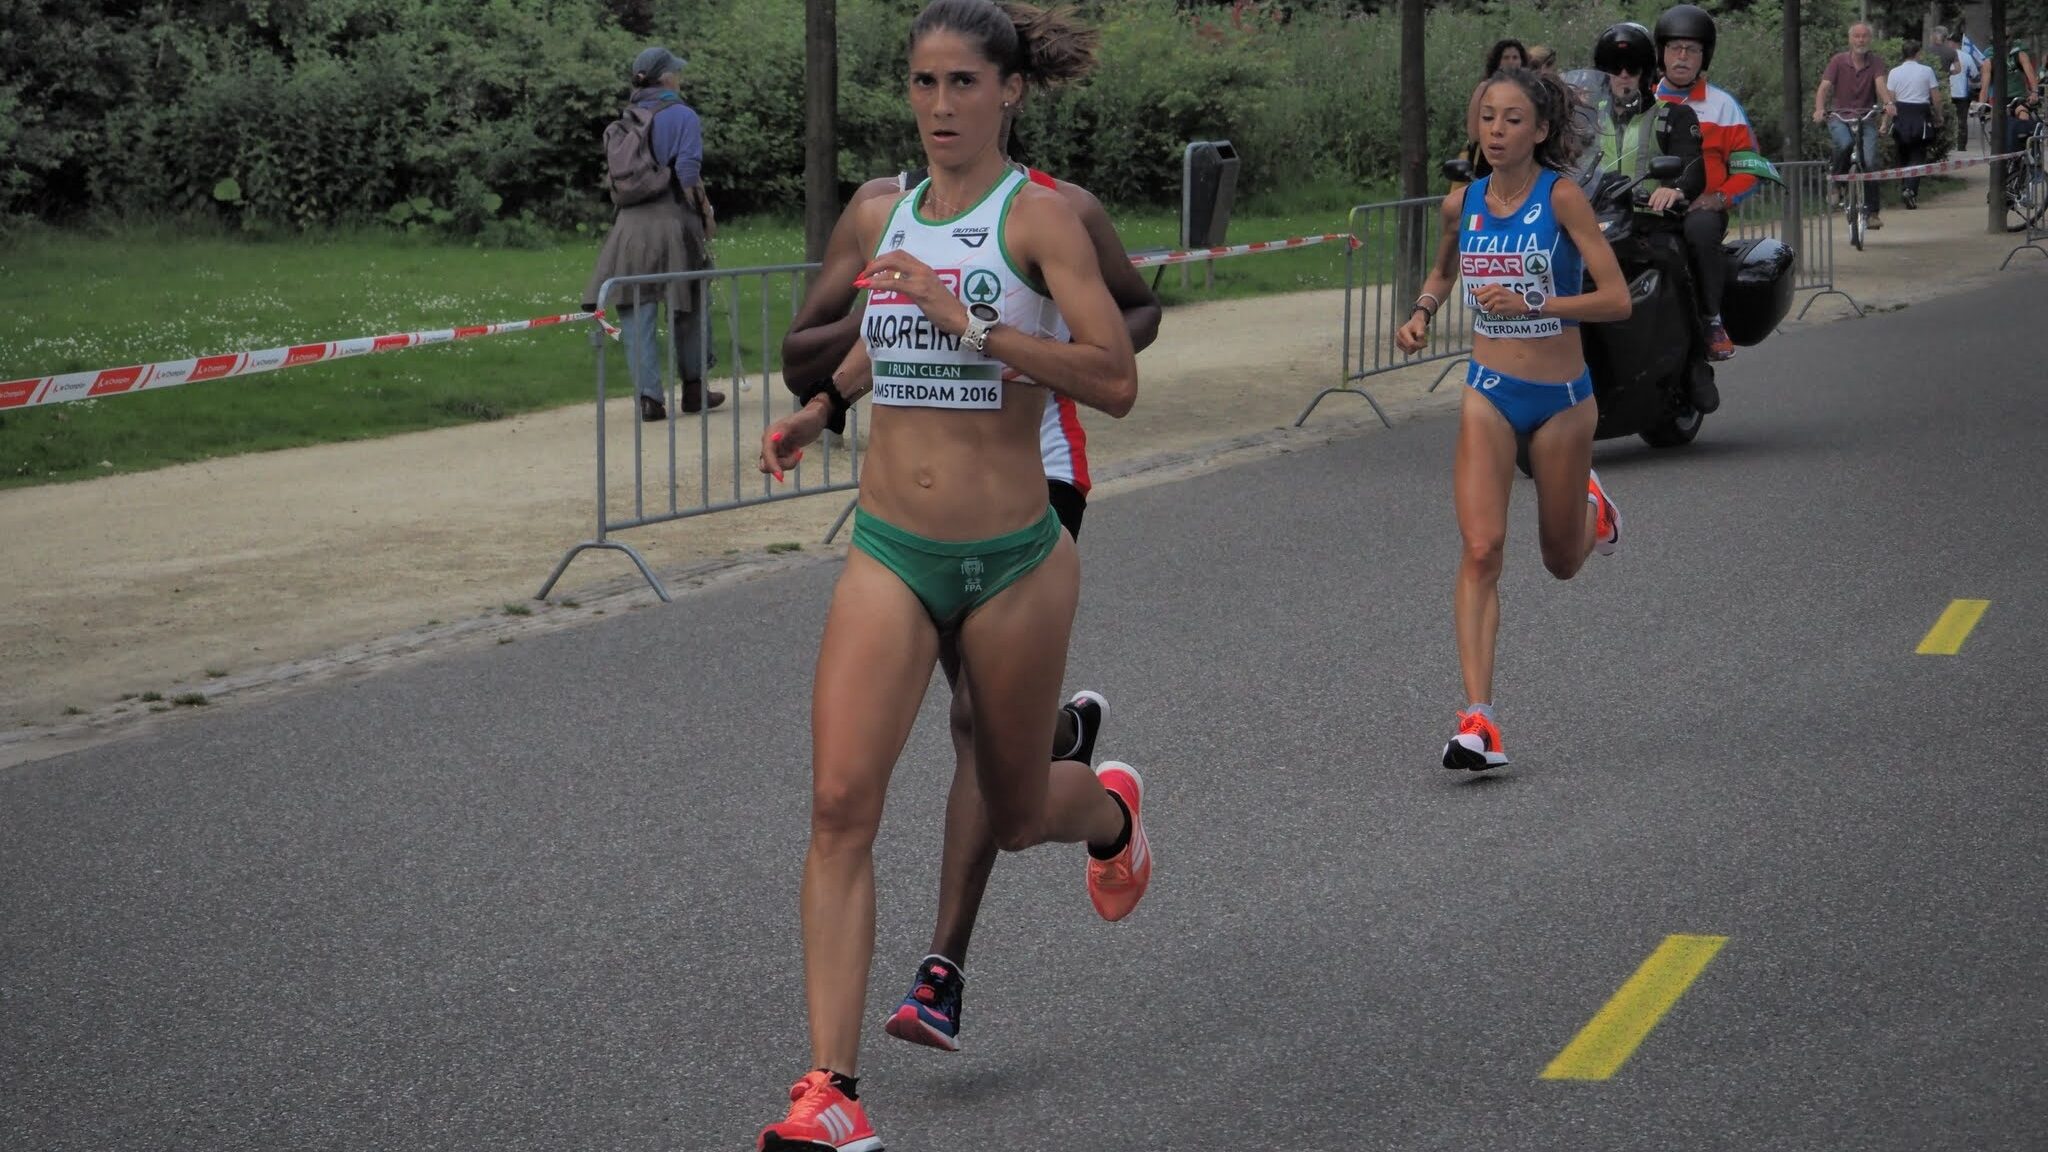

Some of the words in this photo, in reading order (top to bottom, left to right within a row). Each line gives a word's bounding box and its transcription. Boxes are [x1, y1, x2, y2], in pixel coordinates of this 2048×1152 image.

[1467, 233, 1538, 253] ITALIA
[1463, 258, 1522, 274] SPAR
[1534, 321, 1559, 334] 2016
[893, 363, 916, 376] RUN
[919, 365, 960, 378] CLEAN
[874, 384, 955, 401] AMSTERDAM
[960, 386, 998, 402] 2016
[965, 584, 982, 592] FPA
